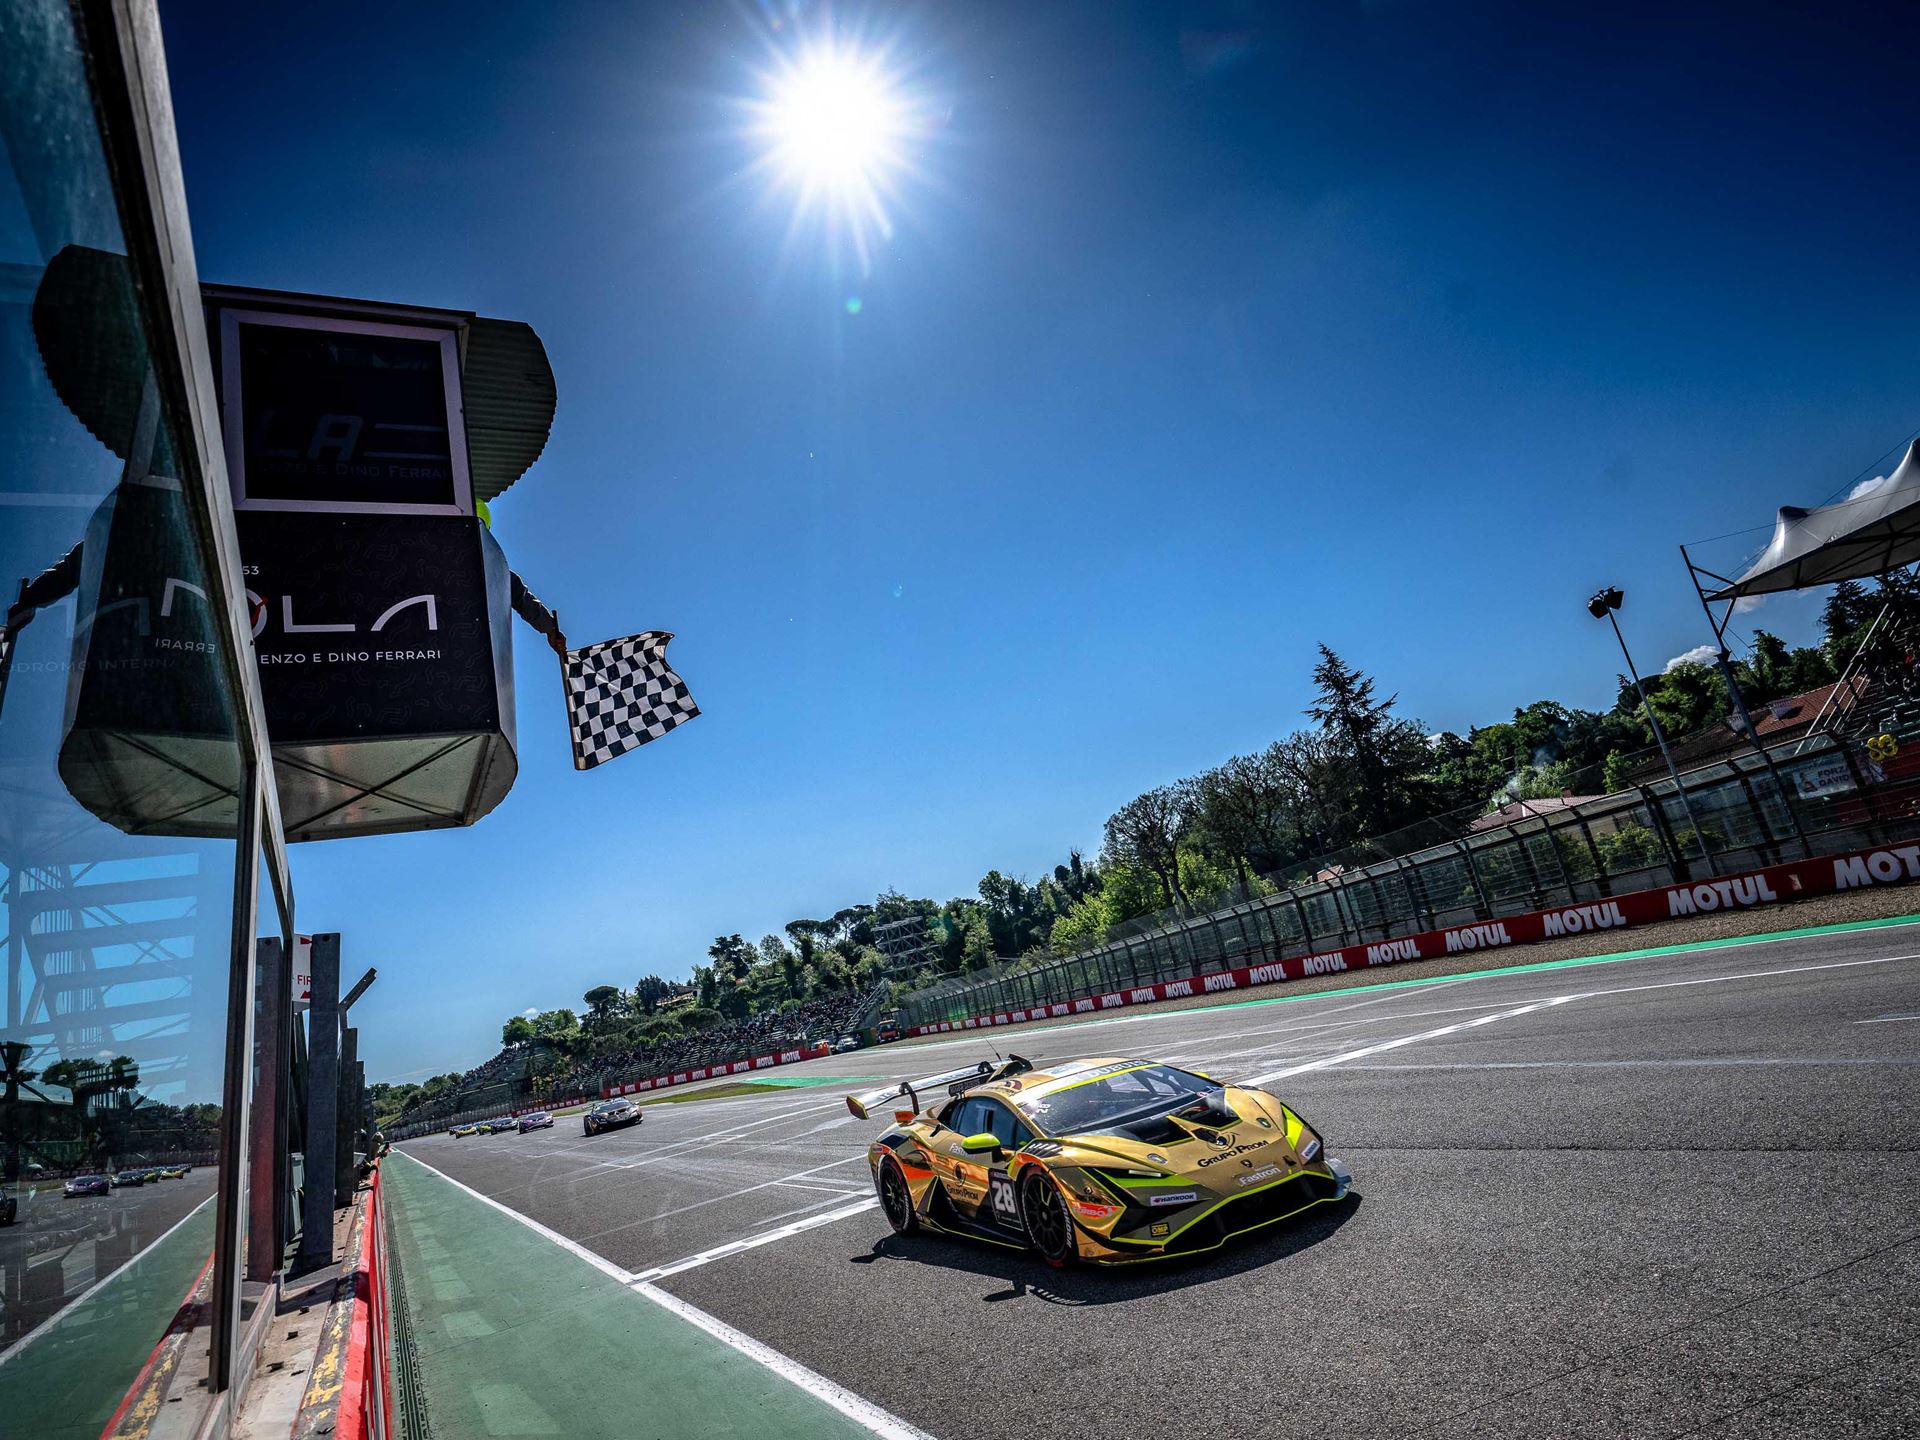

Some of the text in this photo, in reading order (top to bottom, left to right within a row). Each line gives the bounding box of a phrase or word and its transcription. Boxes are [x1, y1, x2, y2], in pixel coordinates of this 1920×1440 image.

[260, 650, 441, 665] ENZO E DINO FERRARI
[1667, 874, 1777, 917] MOTUL
[1542, 902, 1627, 937] MOTUL
[1445, 922, 1511, 952] MOTUL
[1367, 938, 1421, 965] MOTUL
[1249, 963, 1287, 984] MOTUL
[1302, 952, 1348, 976] MOTUL
[1165, 980, 1193, 998] MOTUL
[1204, 972, 1237, 992] MOTUL
[1075, 998, 1095, 1012] MOTUL
[1101, 992, 1123, 1009] MOTUL
[1131, 987, 1156, 1004] MOTUL
[756, 1055, 775, 1068] MOTUL
[781, 1050, 801, 1064] MOTUL
[1197, 1147, 1238, 1169] GRUPO
[1235, 1139, 1270, 1156] PROM
[1238, 1166, 1282, 1187] Fastron
[990, 1179, 1017, 1214] 28
[1151, 1224, 1169, 1235] OMP
